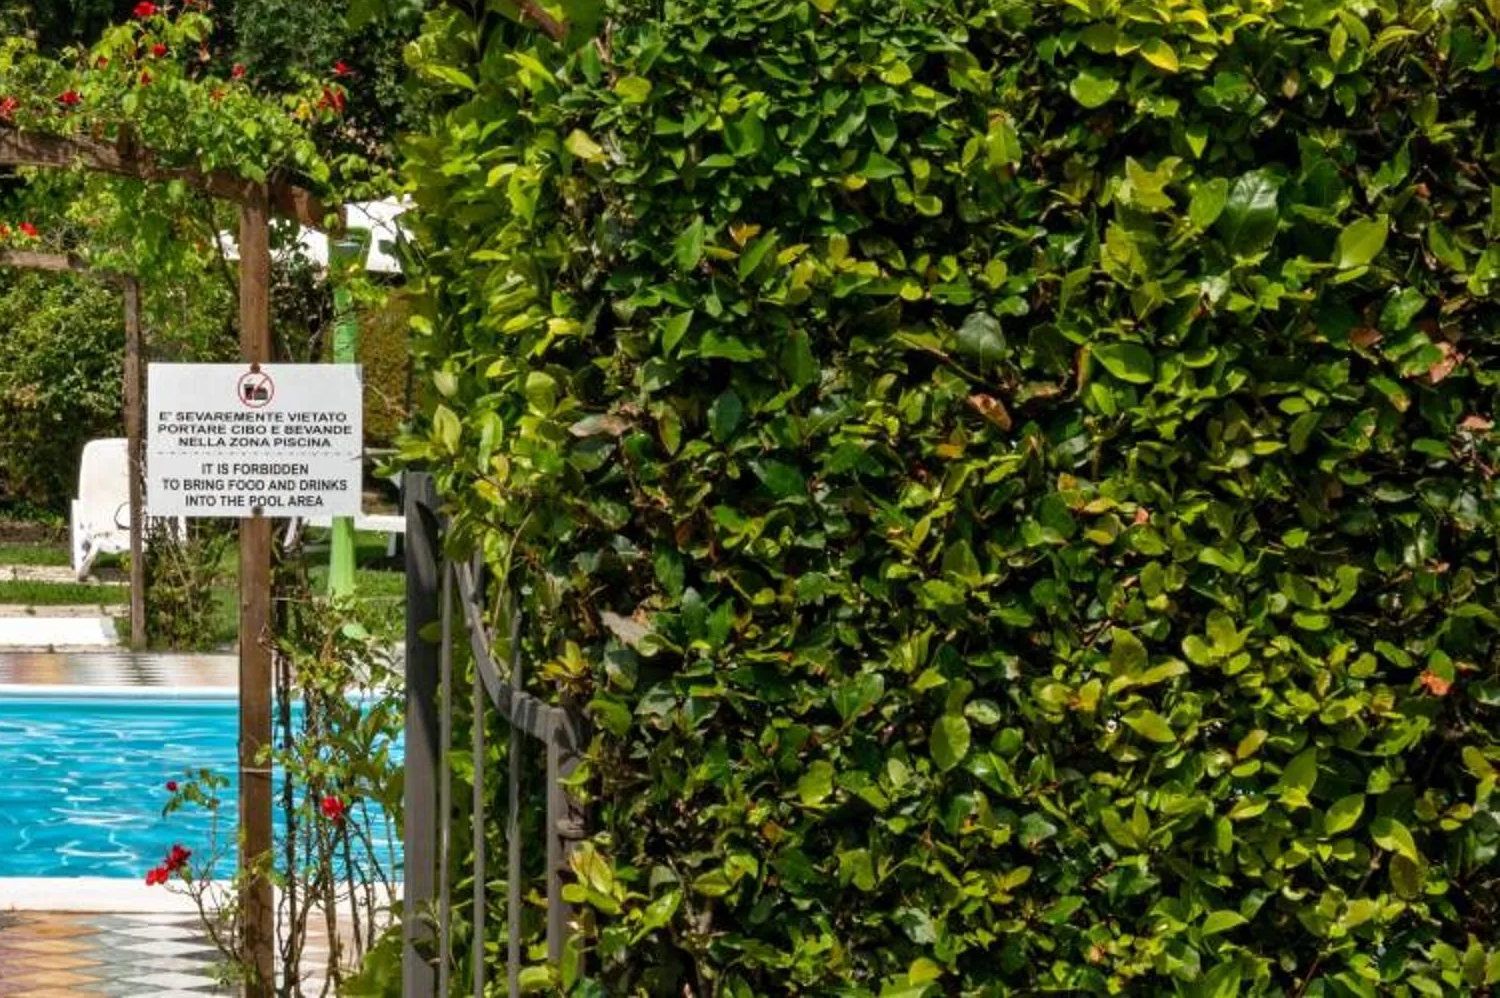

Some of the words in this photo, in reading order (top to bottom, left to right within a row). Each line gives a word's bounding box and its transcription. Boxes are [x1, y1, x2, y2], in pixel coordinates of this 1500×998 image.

[176, 411, 283, 422] SEVAREMENTE
[287, 411, 347, 422] VIETATO
[158, 424, 227, 435] PORTARE
[231, 424, 267, 435] CIBO
[271, 424, 280, 435] E
[284, 424, 352, 435] BEVANDE
[178, 437, 226, 447] NELLA
[229, 437, 271, 447] ZONA
[273, 437, 332, 447] PISCINA
[201, 463, 214, 475] IT
[217, 463, 229, 475] IS
[233, 463, 309, 475] FORBIDDEN
[162, 479, 180, 491] TO
[183, 479, 225, 491] BRING
[227, 479, 266, 491] FOOD
[267, 479, 296, 491] AND
[299, 479, 349, 491] DRINKS
[185, 495, 217, 507] INTO
[220, 495, 245, 507] THE
[248, 495, 284, 507] POOL
[287, 495, 324, 507] AREA
